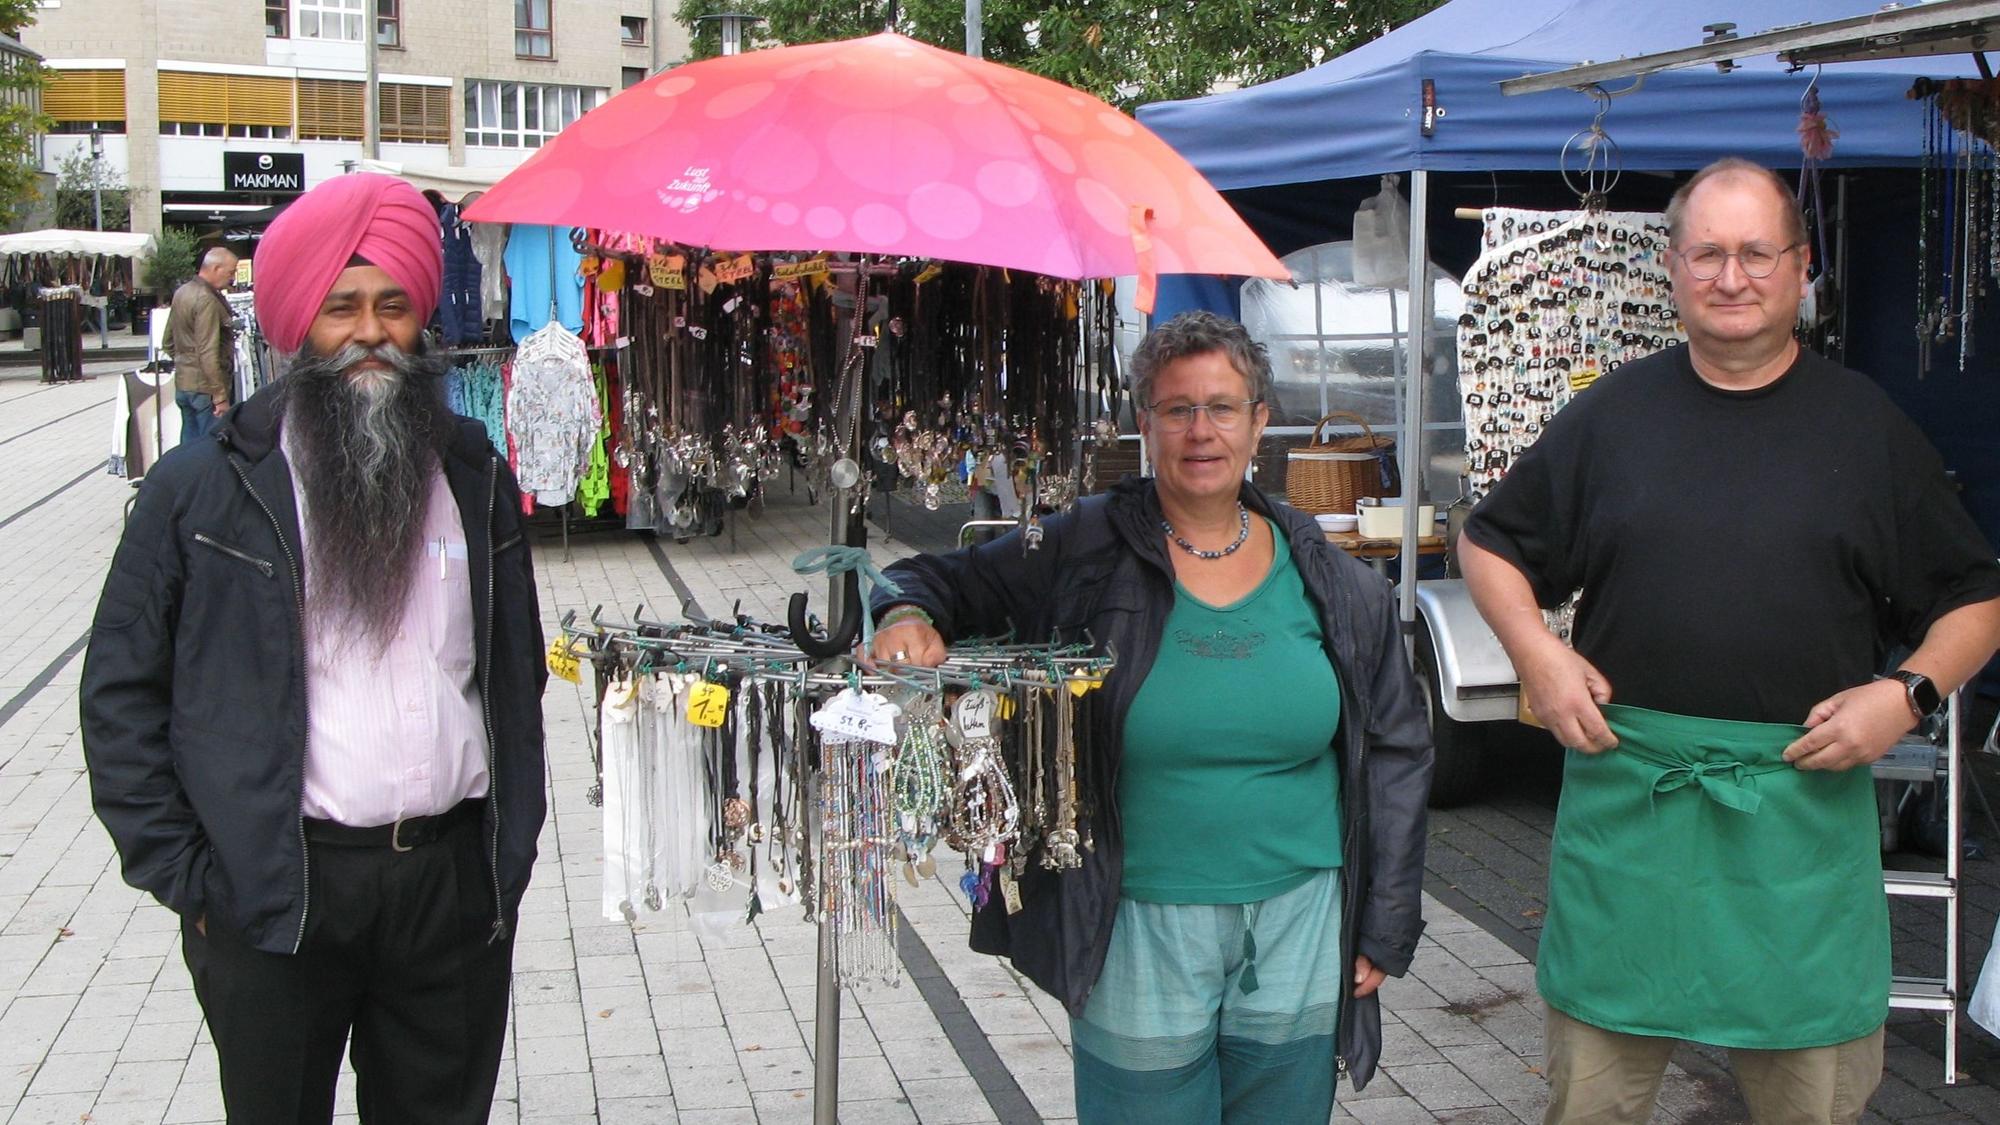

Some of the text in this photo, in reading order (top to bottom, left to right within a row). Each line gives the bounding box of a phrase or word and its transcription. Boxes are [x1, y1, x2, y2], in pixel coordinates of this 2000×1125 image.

[684, 166, 710, 177] Lust
[234, 173, 298, 188] MAKIMAN
[666, 179, 711, 193] Zukunft
